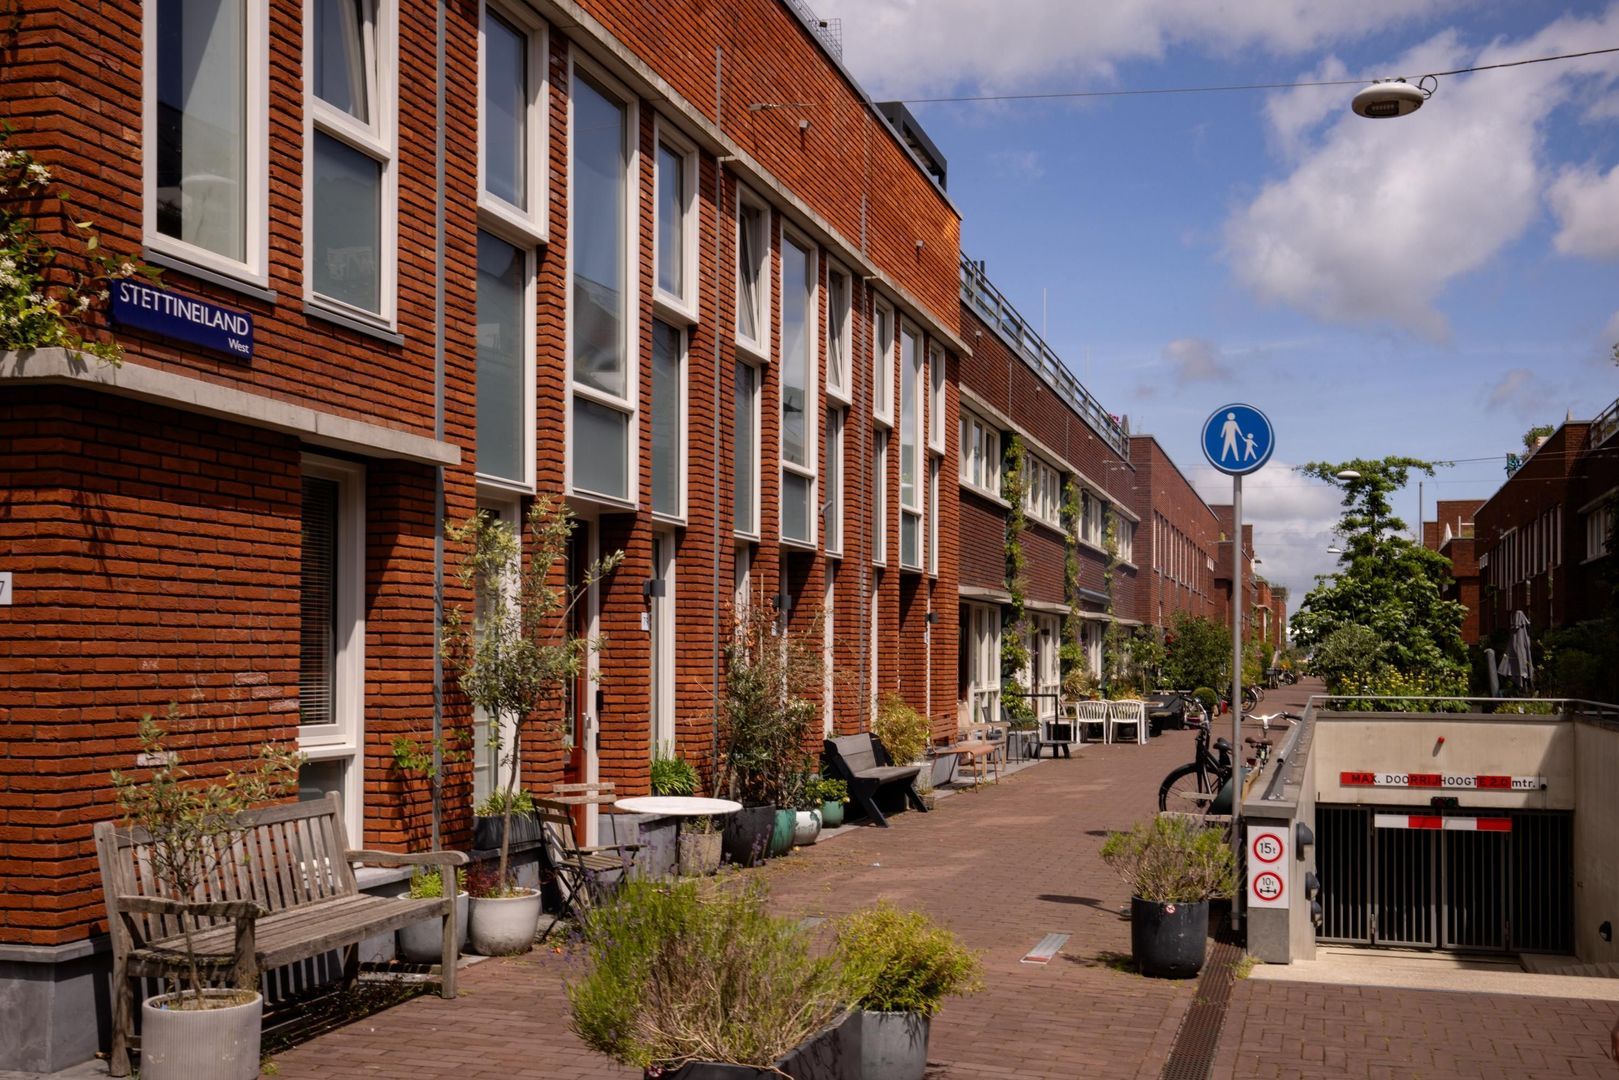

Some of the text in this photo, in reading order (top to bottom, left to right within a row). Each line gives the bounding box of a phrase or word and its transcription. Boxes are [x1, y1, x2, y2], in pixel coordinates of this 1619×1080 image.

[120, 282, 249, 336] STETTINEILAND
[228, 338, 249, 353] West
[1351, 774, 1381, 784] MAX.
[1385, 775, 1485, 787] DOORRIJHOOGTE
[1511, 779, 1536, 788] mtr.
